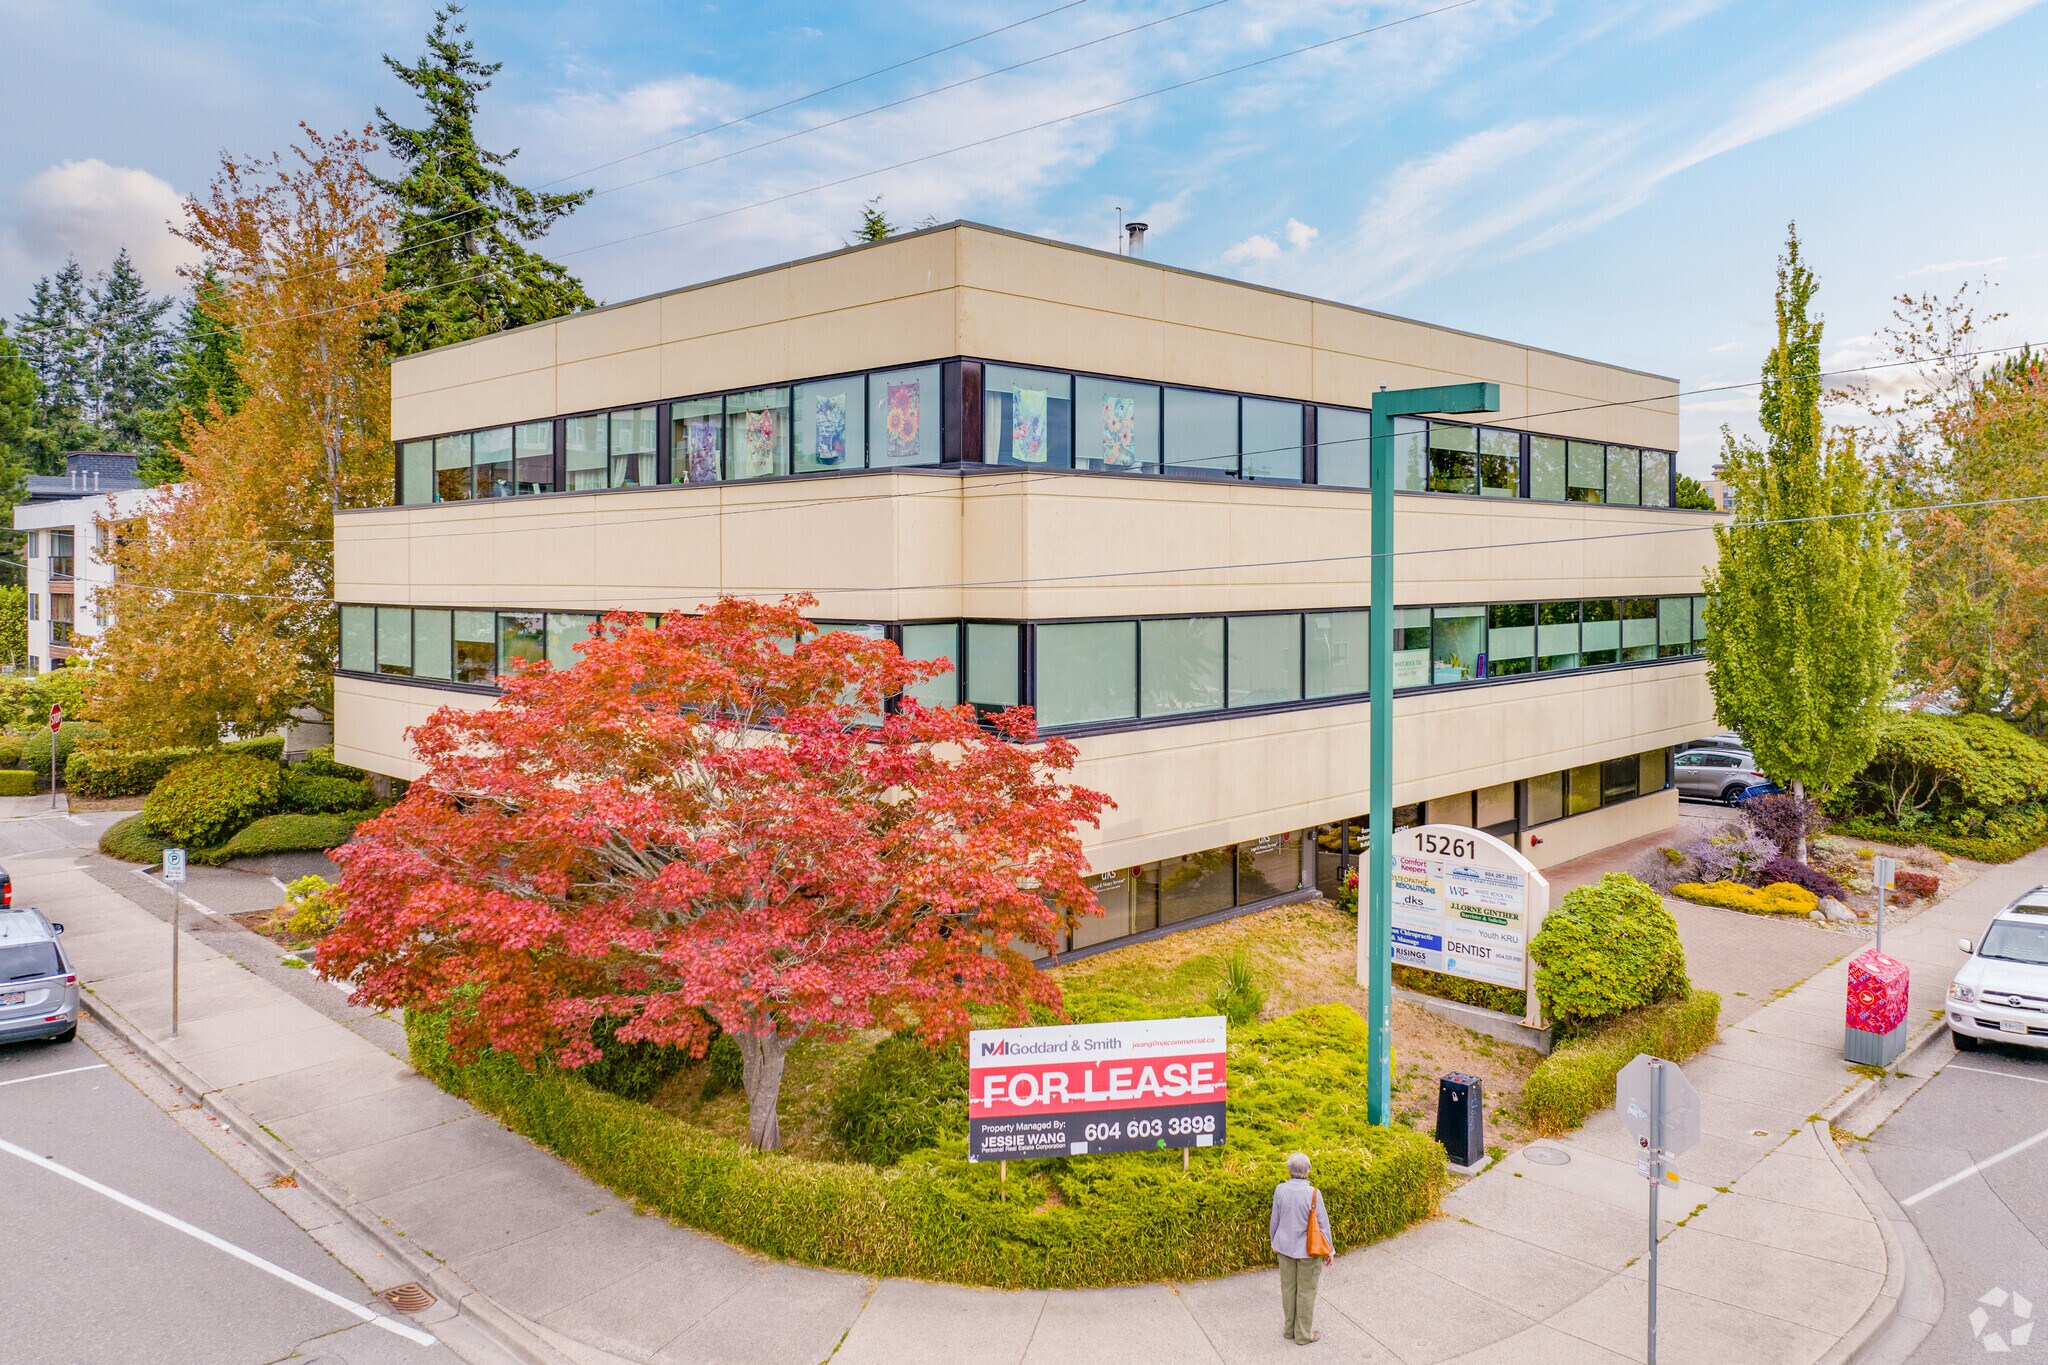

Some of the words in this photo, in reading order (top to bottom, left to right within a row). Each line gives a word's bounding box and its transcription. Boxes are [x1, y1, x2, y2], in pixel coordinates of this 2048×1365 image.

[1415, 833, 1475, 859] 15261
[1400, 857, 1427, 868] Comfort
[1401, 864, 1427, 874] Keepers
[1395, 882, 1436, 894] RESOLUTIONS
[1404, 895, 1424, 906] dks
[1451, 902, 1482, 914] J.LORNE
[1484, 909, 1519, 920] GINTHER
[1461, 912, 1482, 920] Barrister
[1487, 917, 1507, 925] Solicitor
[1400, 929, 1434, 941] Chiropractic
[1479, 930, 1499, 939] Youth
[1501, 934, 1518, 943] KRU
[1396, 948, 1426, 959] RISINGS
[1448, 941, 1491, 959] DENTIST
[1395, 955, 1426, 964] EDUCATION
[981, 1039, 1009, 1056] NAI
[1010, 1040, 1068, 1055] Goddard
[1071, 1040, 1080, 1051] &
[1084, 1037, 1122, 1051] Smith
[1132, 1037, 1215, 1049] jwang@naicommercial.ca
[984, 1071, 1069, 1108] FOR
[1084, 1062, 1215, 1102] LEASE
[981, 1124, 1014, 1134] Property
[1016, 1121, 1051, 1131] Managed
[1053, 1120, 1066, 1130] By:
[1085, 1122, 1121, 1142] 604
[1126, 1119, 1163, 1139] 603
[1168, 1115, 1215, 1136] 3898
[981, 1134, 1025, 1148] JESSIE
[1027, 1132, 1066, 1144] WANG
